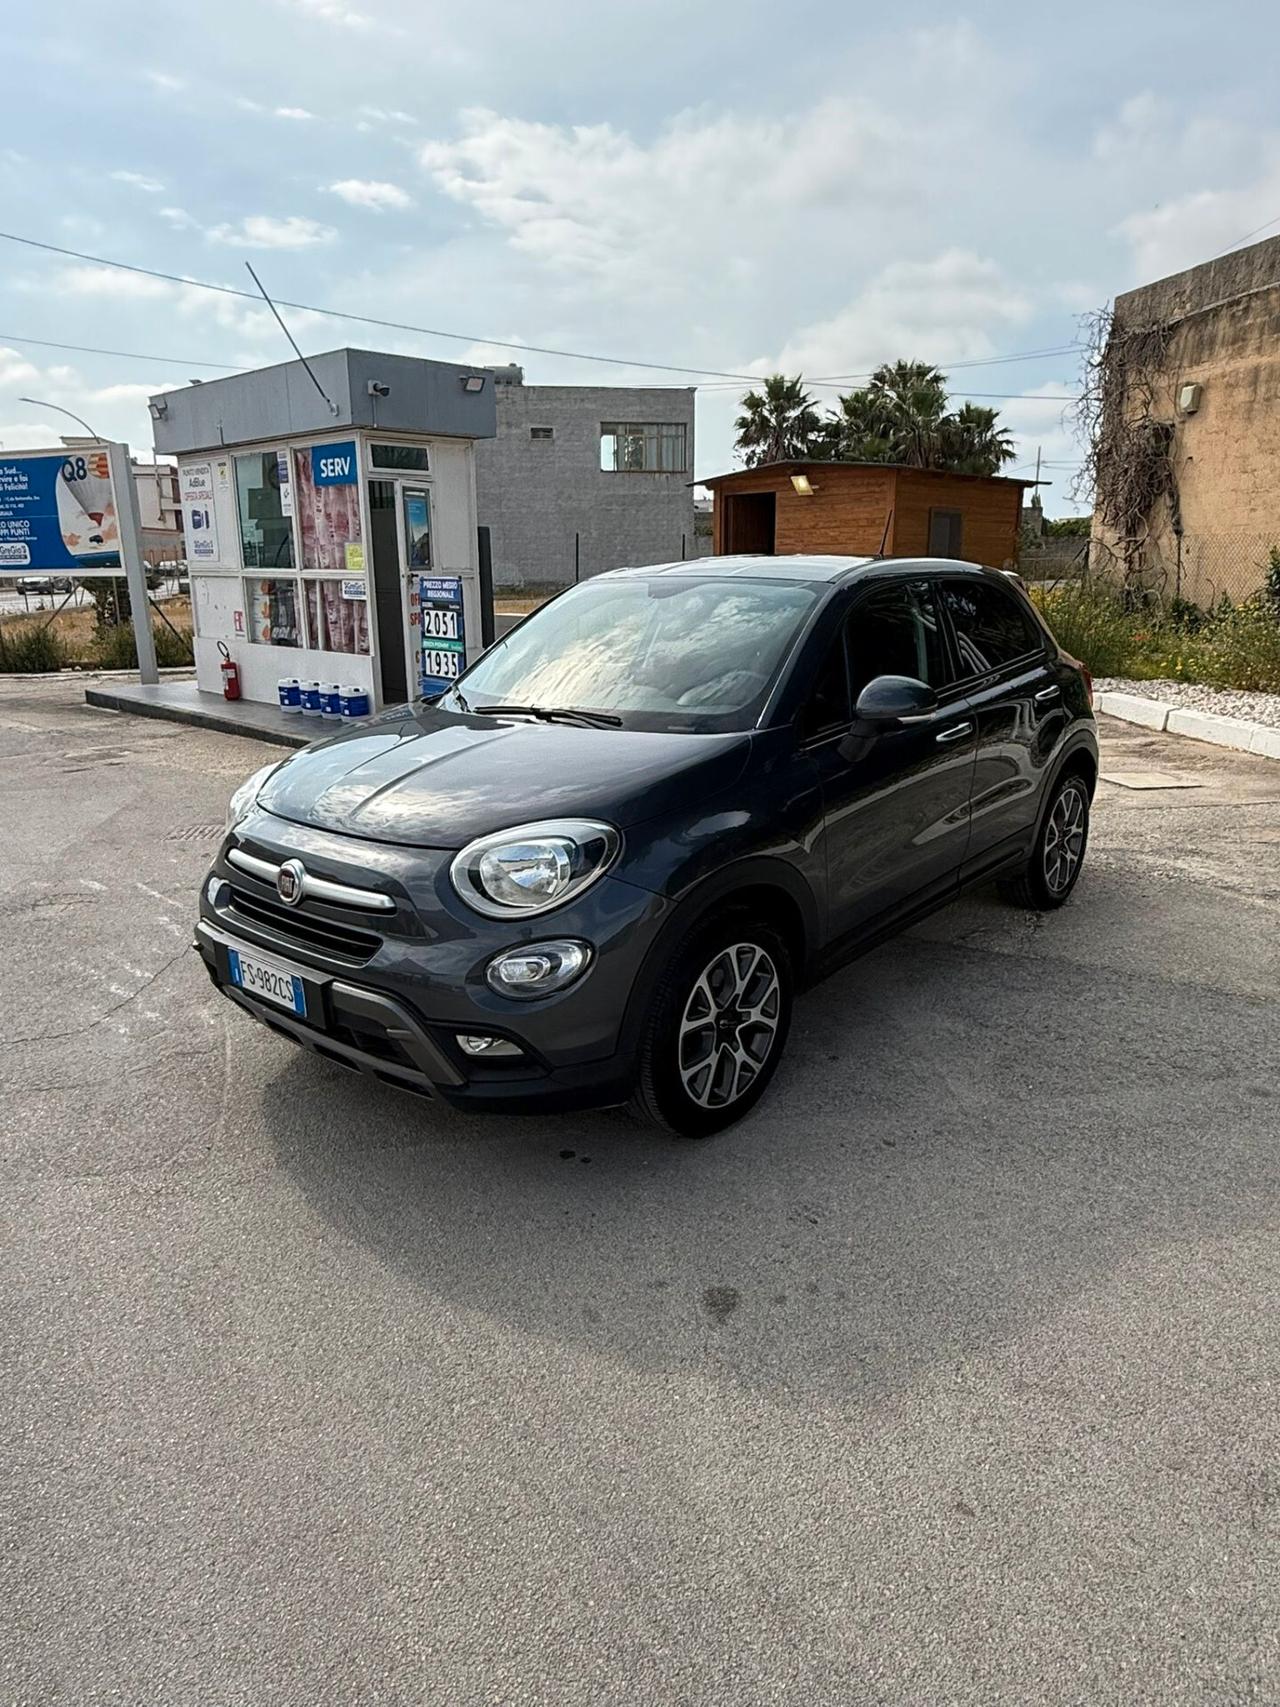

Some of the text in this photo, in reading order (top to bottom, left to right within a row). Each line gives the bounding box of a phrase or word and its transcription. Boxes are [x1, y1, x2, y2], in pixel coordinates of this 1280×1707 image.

[62, 457, 87, 482] Q8
[320, 456, 350, 478] SERV
[7, 520, 30, 528] UNICO
[423, 580, 442, 589] PREZZO
[427, 590, 454, 598] REGIONALE
